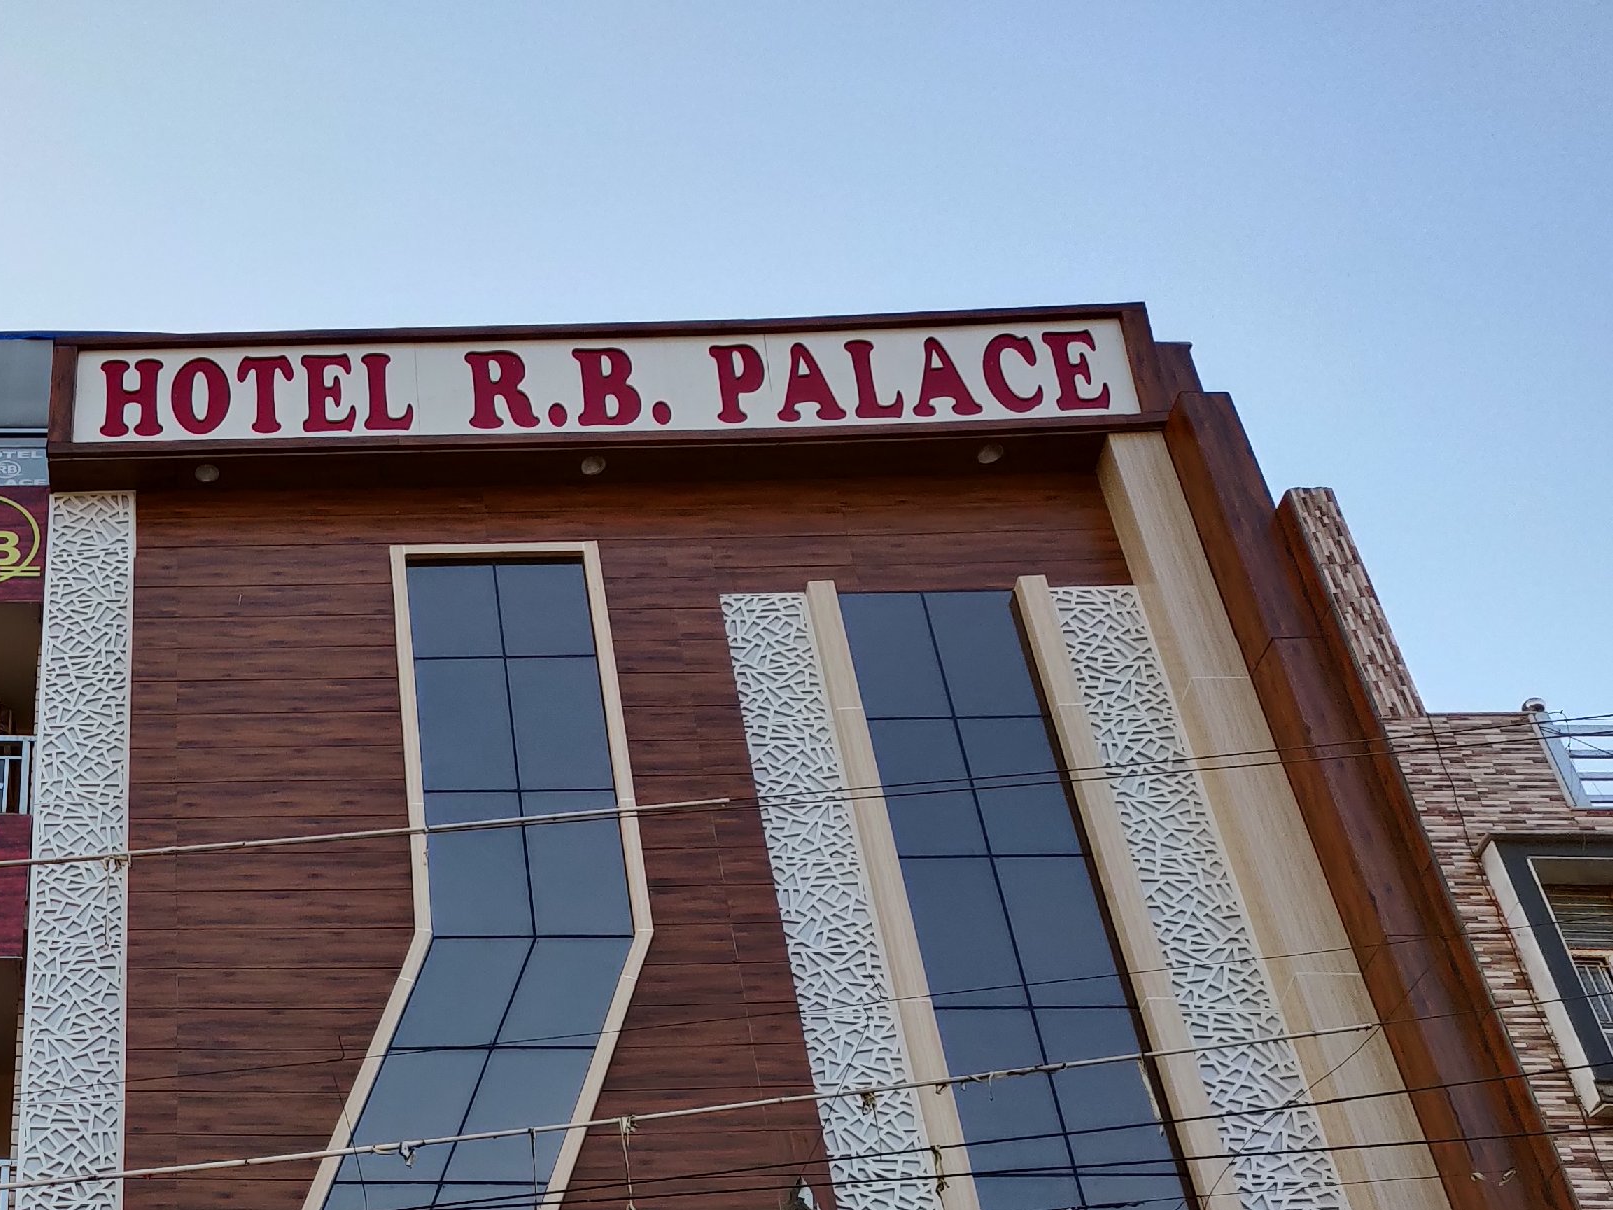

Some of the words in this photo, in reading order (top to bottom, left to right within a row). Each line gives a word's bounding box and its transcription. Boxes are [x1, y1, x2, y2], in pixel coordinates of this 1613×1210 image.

[99, 352, 415, 439] HOTEL
[464, 346, 673, 431] R.B.
[706, 329, 1113, 424] PALACE
